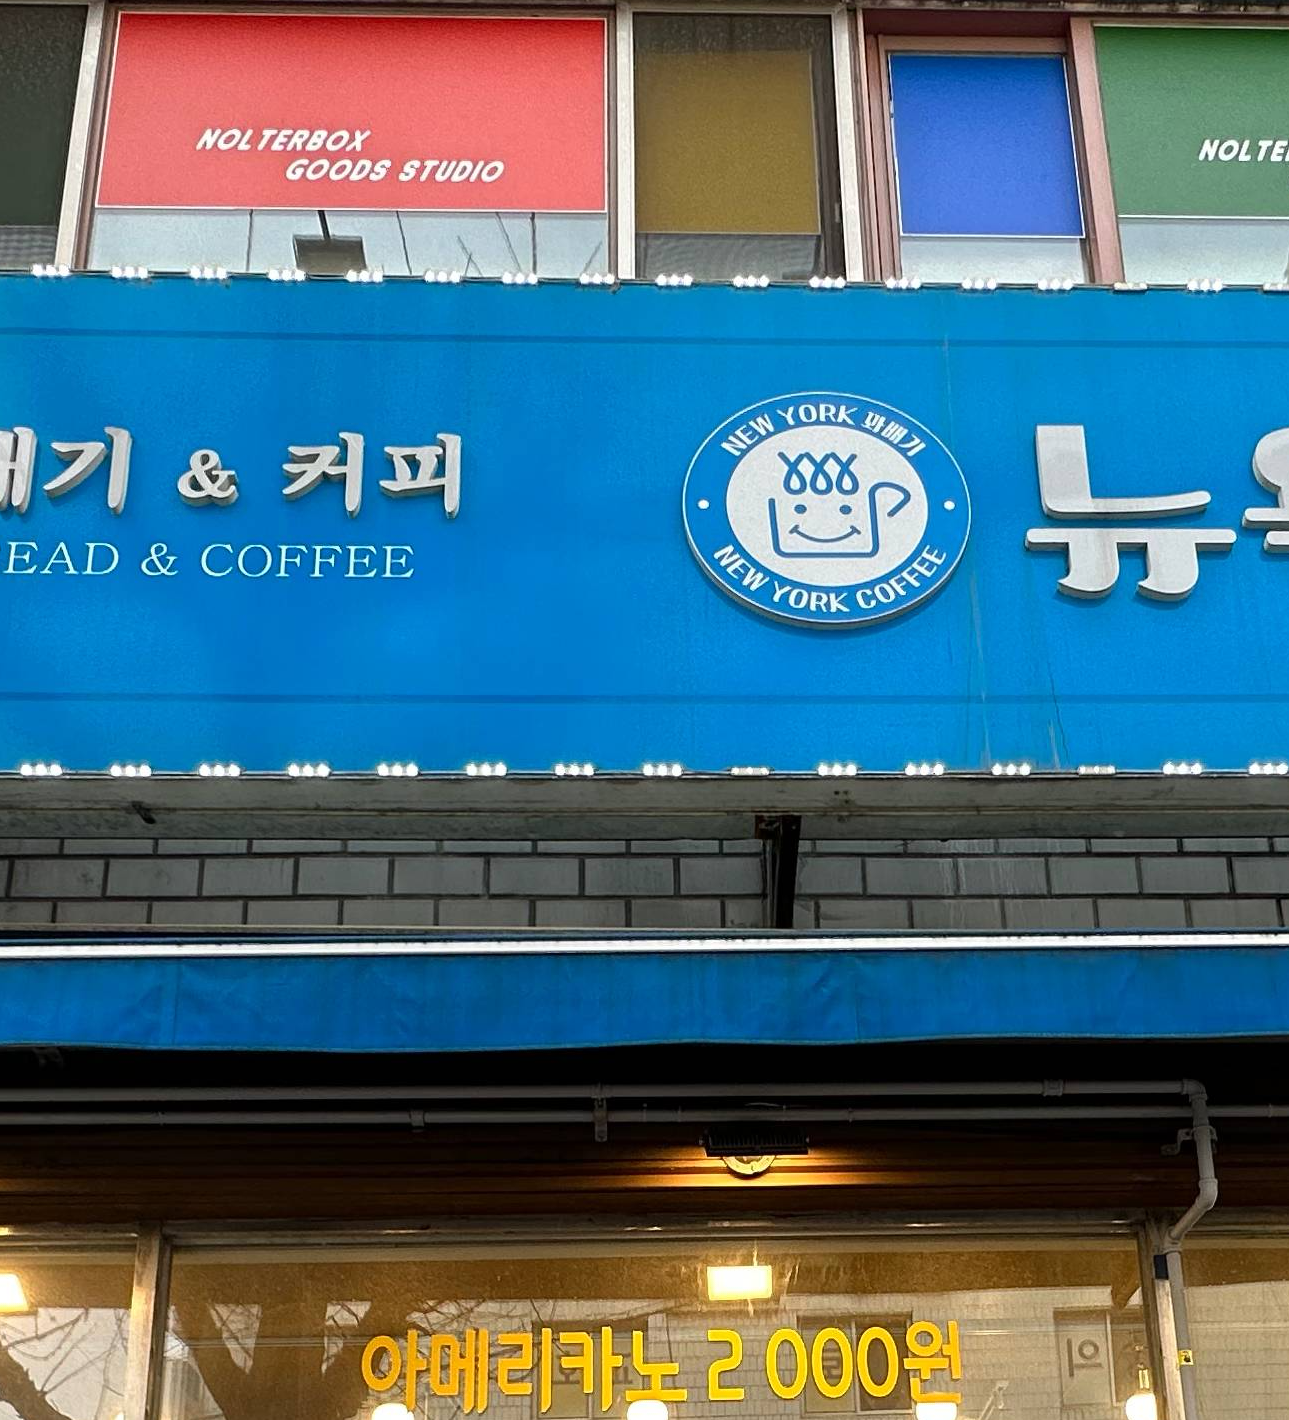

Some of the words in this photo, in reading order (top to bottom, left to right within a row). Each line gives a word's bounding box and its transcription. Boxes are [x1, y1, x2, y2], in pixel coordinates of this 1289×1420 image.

[195, 128, 371, 152] NOLTERBOX
[285, 159, 393, 183] GOODS
[397, 159, 506, 183] STUDIO
[720, 414, 775, 456] NEW
[777, 404, 858, 426] YORK
[862, 411, 927, 457] 꽈배기
[177, 447, 239, 506] &
[281, 431, 463, 519] 커피
[140, 542, 178, 578] &
[198, 543, 416, 580] COFFEE
[713, 544, 770, 592] NEW
[772, 581, 851, 613] YORK
[855, 544, 948, 609] COFFEE
[361, 1326, 688, 1413] 아메리카노
